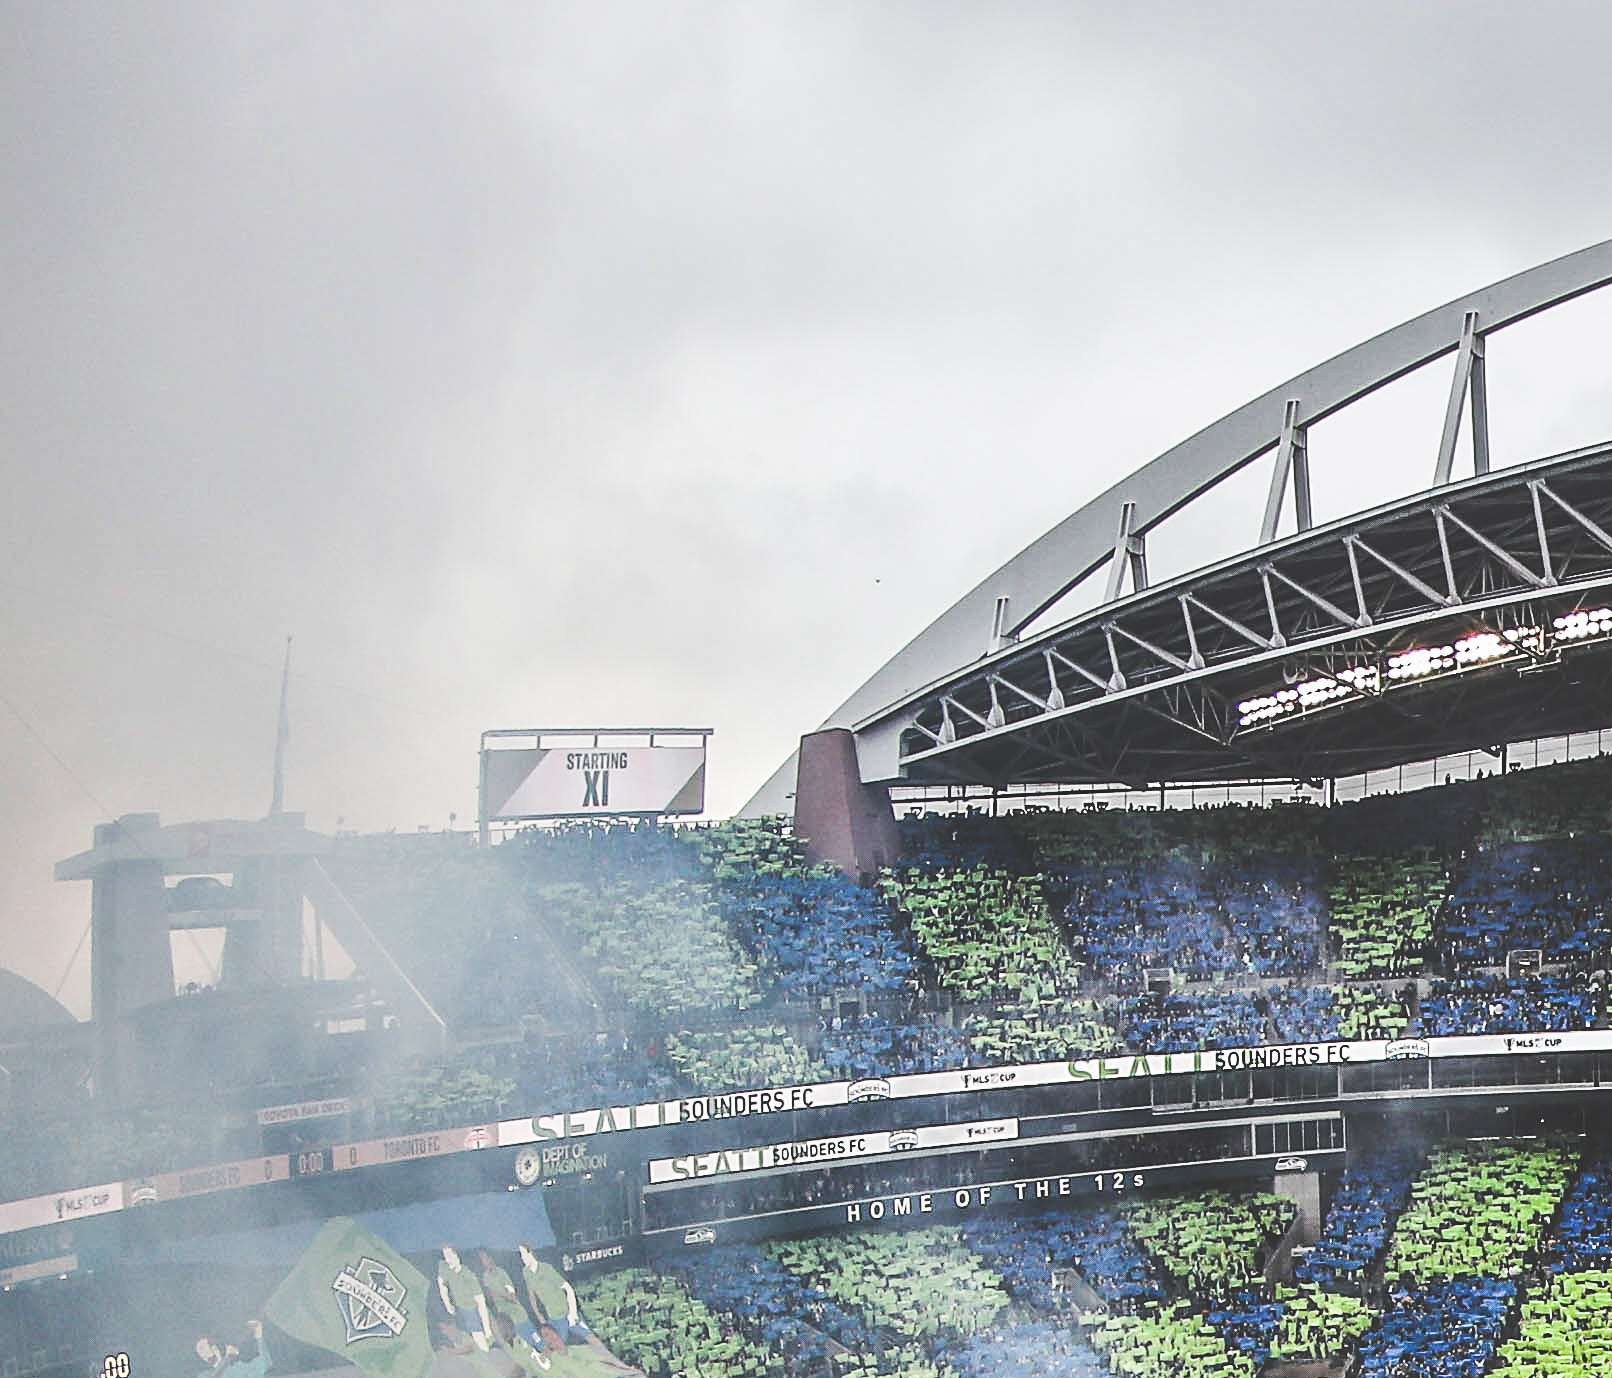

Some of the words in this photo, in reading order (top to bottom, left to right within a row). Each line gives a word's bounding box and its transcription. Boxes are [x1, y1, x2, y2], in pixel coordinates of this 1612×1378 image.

[566, 751, 628, 771] STARTING
[582, 770, 609, 807] XI
[1215, 1047, 1320, 1070] SOUNDERS
[1327, 1044, 1351, 1064] FC
[791, 1088, 814, 1109] FC
[541, 1145, 573, 1162] DEPT
[574, 1142, 588, 1159] OF
[773, 1142, 846, 1162] SOUNDERS
[849, 1139, 866, 1153] FC
[847, 1193, 935, 1222] HOME
[956, 1185, 993, 1208] OF
[1014, 1177, 1072, 1200] THE
[1094, 1172, 1145, 1193] 12s
[575, 1245, 624, 1262] STARBUCKS
